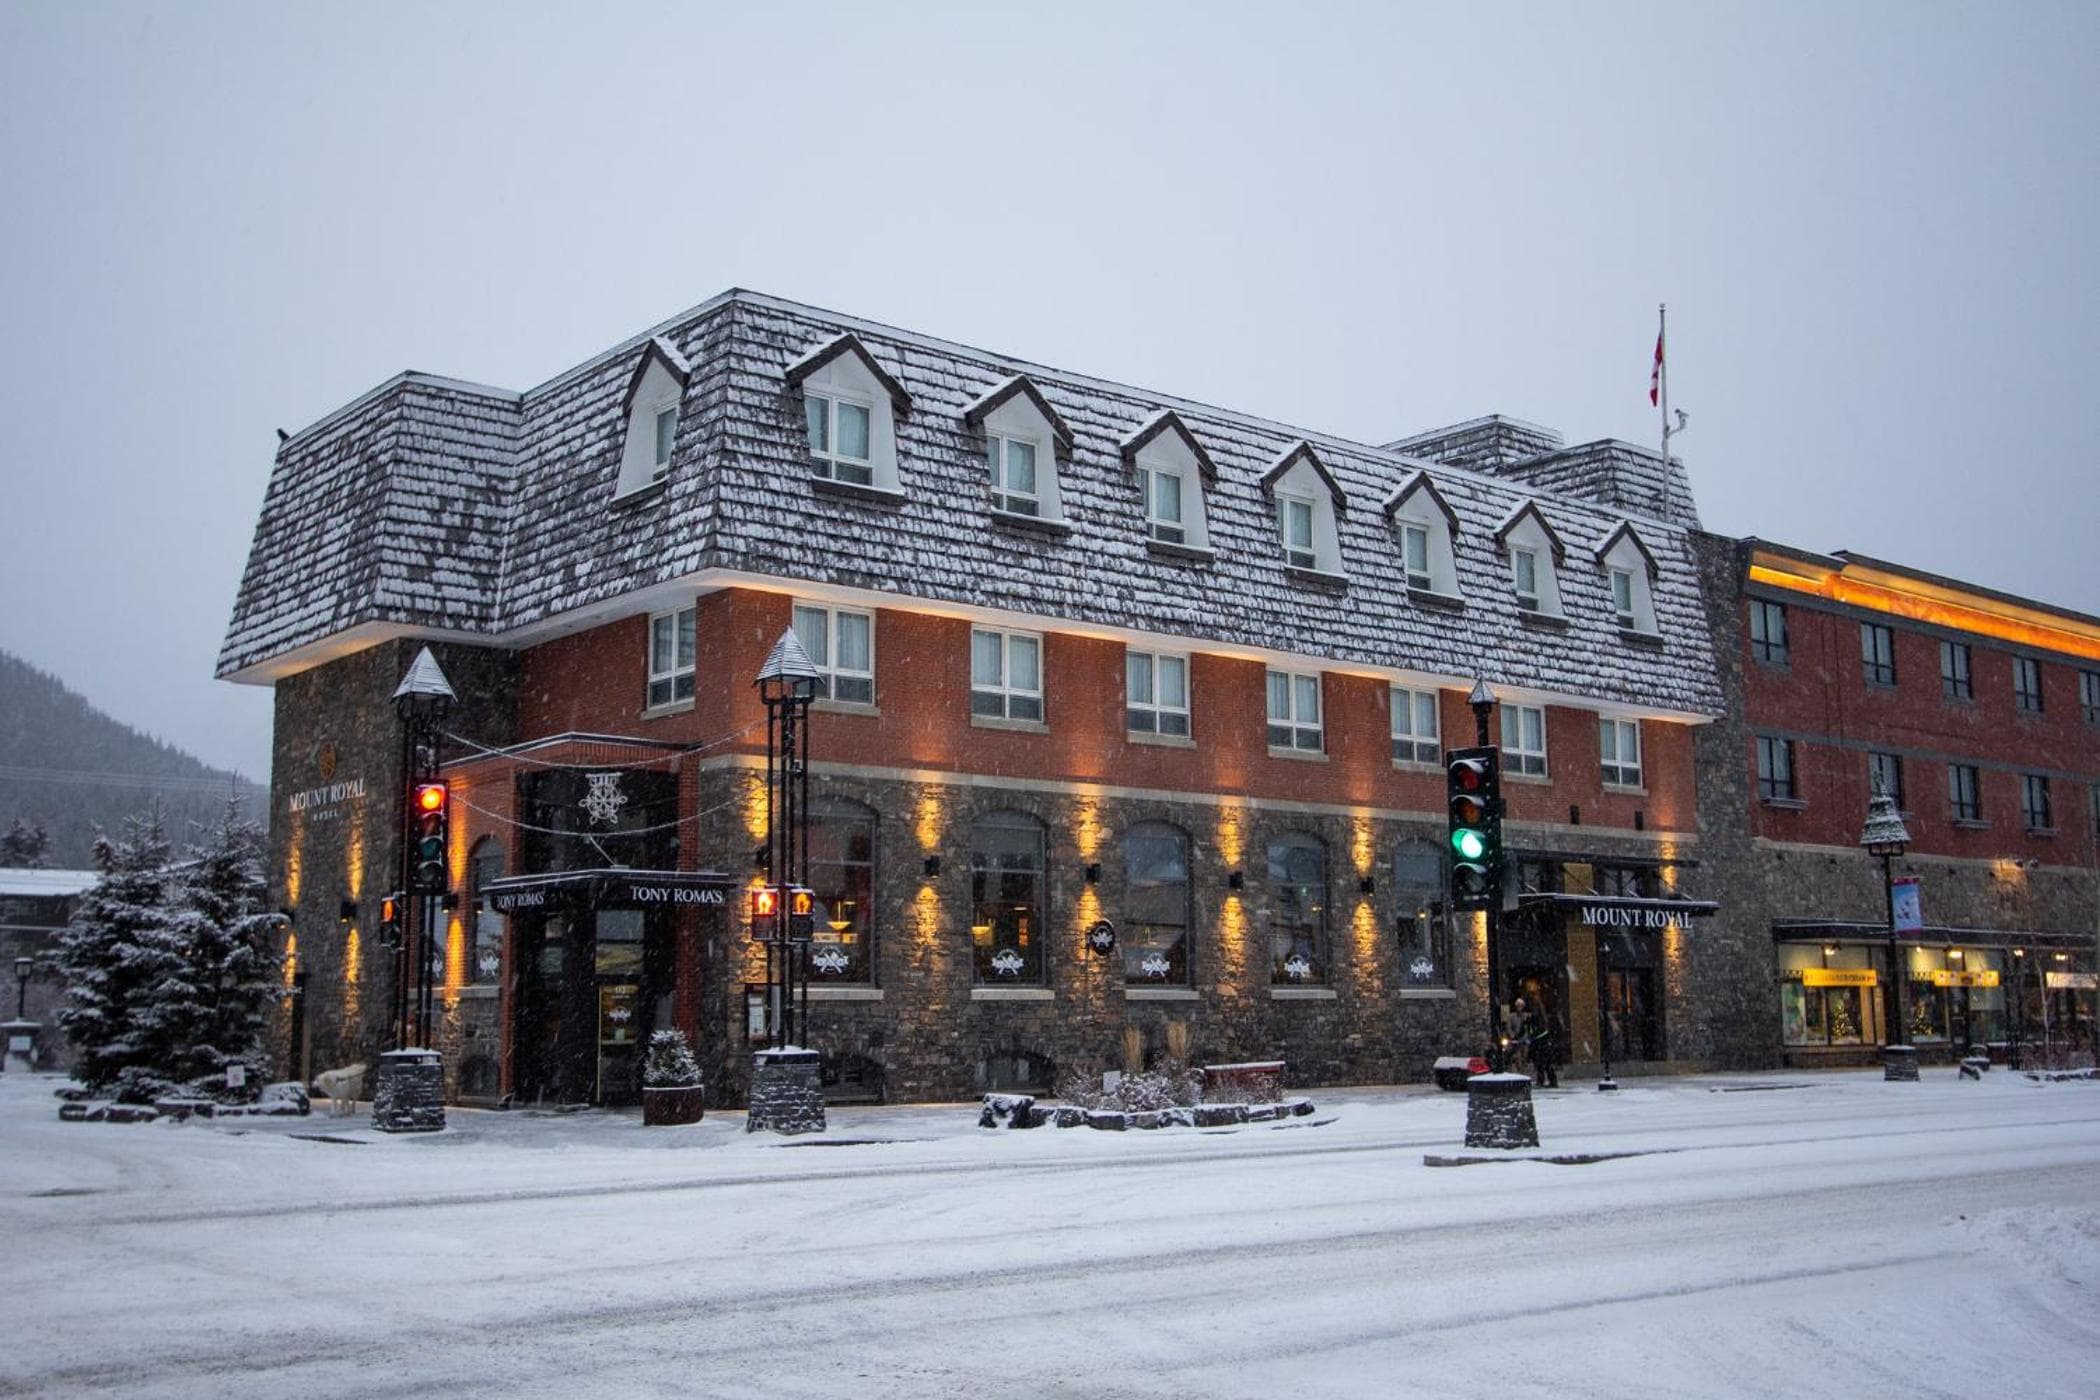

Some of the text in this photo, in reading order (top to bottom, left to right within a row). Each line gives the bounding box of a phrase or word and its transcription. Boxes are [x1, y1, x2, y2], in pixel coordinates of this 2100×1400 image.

[289, 778, 366, 812] MOUNT ROYAL
[497, 895, 516, 908] TONY
[630, 885, 724, 904] TONY ROMA'S
[1582, 906, 1693, 929] MOUNT ROYAL
